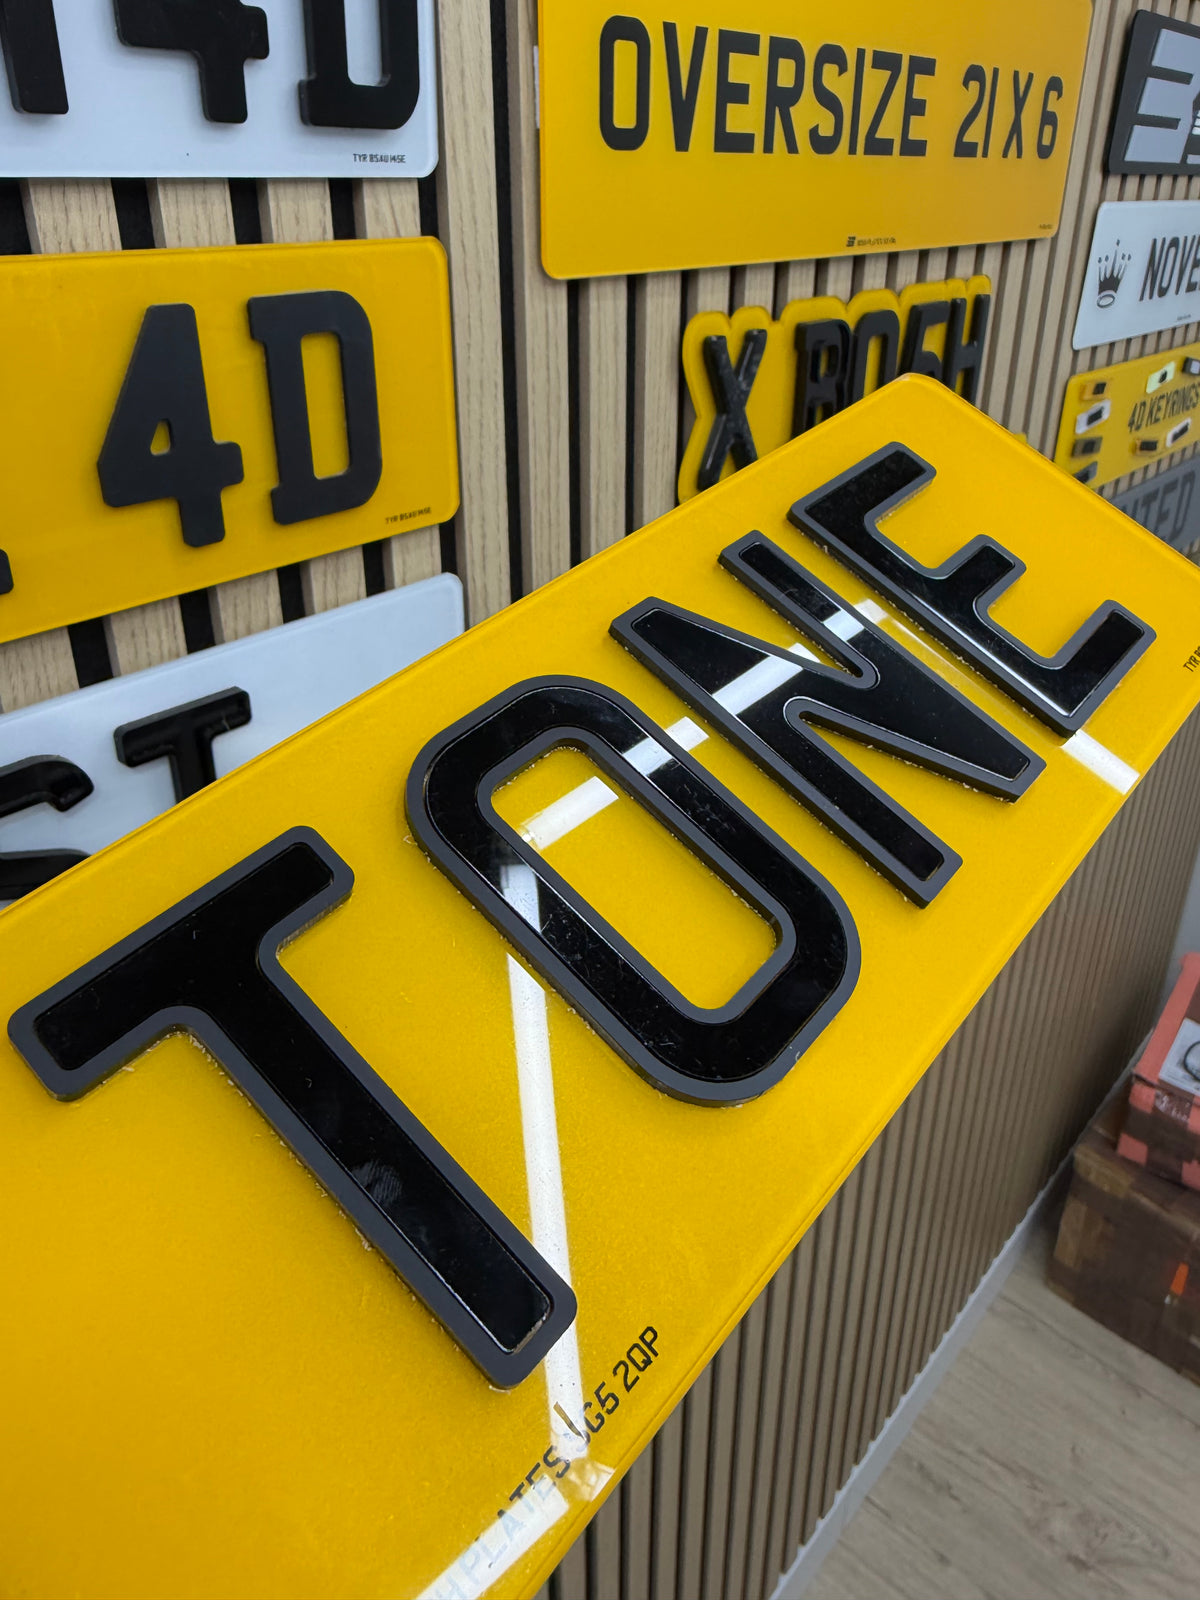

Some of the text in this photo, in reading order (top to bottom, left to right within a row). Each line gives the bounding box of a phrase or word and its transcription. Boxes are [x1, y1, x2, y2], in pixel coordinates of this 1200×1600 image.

[599, 14, 937, 158] OVERSIZE
[953, 63, 1000, 159] 21
[1002, 69, 1034, 159] X
[1036, 75, 1064, 160] 6
[97, 289, 383, 548] 4D
[697, 328, 768, 491] X
[8, 440, 1157, 1390] TONE
[612, 1325, 660, 1393] 2QP
